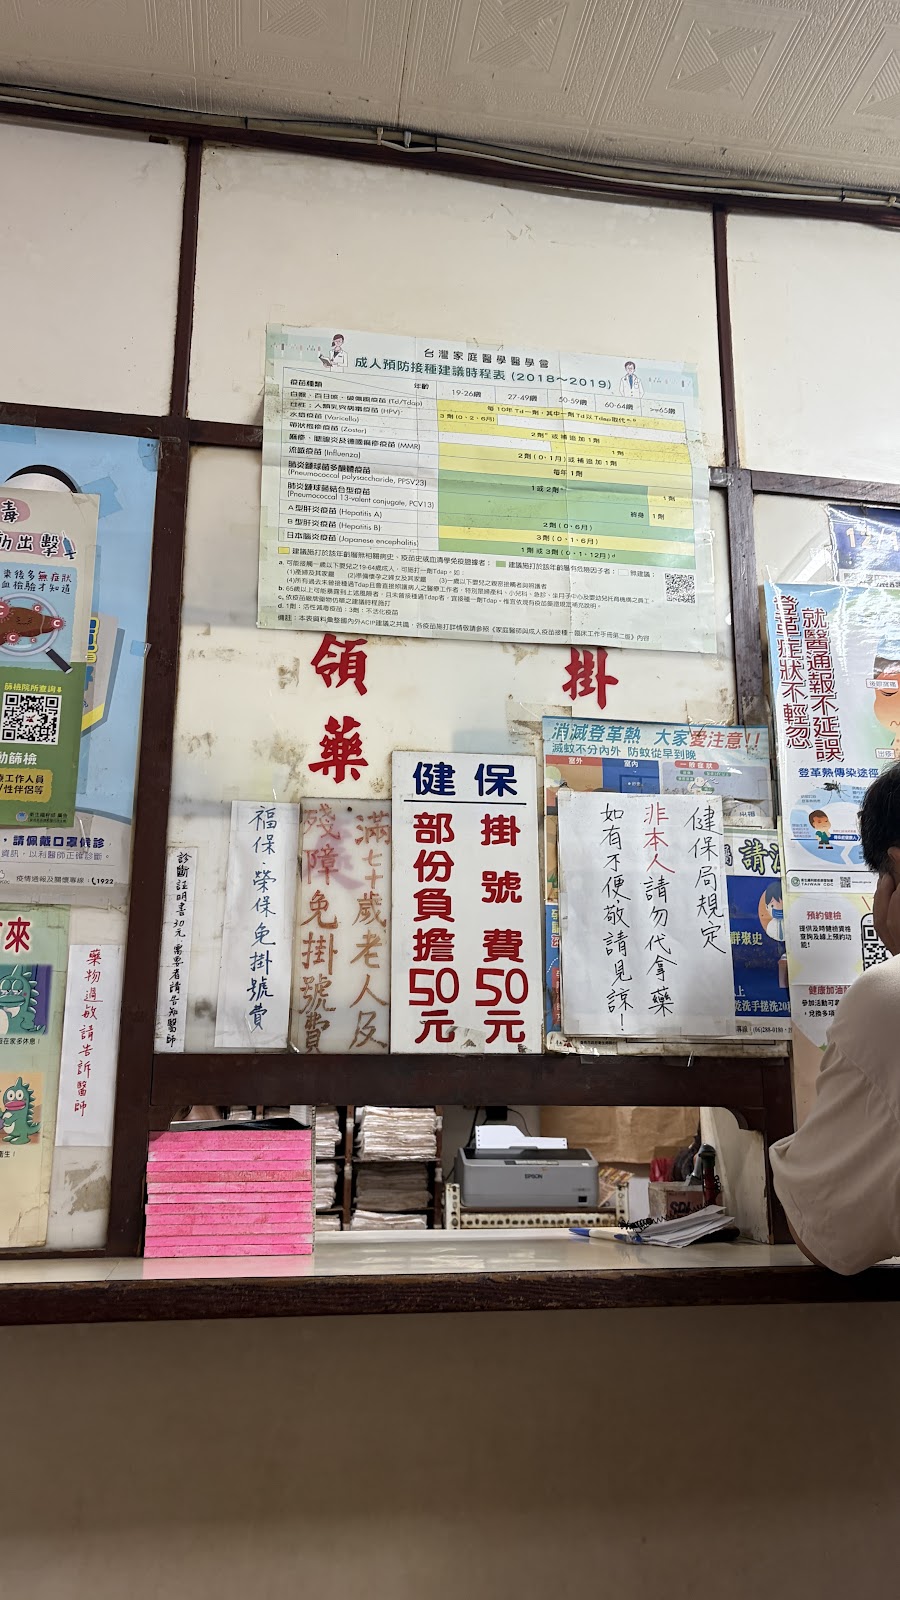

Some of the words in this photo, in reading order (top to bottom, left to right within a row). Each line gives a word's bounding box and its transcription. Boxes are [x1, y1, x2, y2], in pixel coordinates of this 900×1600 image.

[354, 357, 506, 381] 成人預防接種建議時程表
[424, 348, 550, 369] 台灣家庭醫學醫學會
[398, 441, 421, 451] (MMR)
[288, 469, 340, 479] (Pneumococcal
[287, 490, 338, 501] (Pneumococcal
[1, 500, 19, 523] 毒
[339, 507, 372, 518] (Hepatitis
[339, 521, 372, 531] (Hepatitis
[339, 534, 375, 545] (Japanese
[4, 683, 56, 693] 篩檢院所查詢
[562, 647, 620, 710] 掛
[802, 608, 845, 763] 就醫通報不延誤
[308, 633, 369, 784] 領藥
[551, 722, 641, 745] 消滅登革熱
[551, 742, 622, 756] 滅蚊不分內外
[627, 746, 697, 760] 防蚊從早到晚
[413, 761, 518, 797] 健保
[798, 767, 879, 778] 登革熱傳染途徑
[684, 806, 727, 954] 健保局規定
[643, 802, 678, 1018] 非本人請勿代拿藥
[807, 911, 842, 921] 預約健檢
[0, 917, 31, 952] 來
[300, 802, 340, 1053] 殘障免掛號費
[349, 811, 391, 1050] 滿七十歲老人及
[408, 812, 460, 1044] 部份負擔50元
[475, 813, 530, 1044] 掛號費50元
[74, 949, 104, 1117] 藥物過敏請告訴醫師
